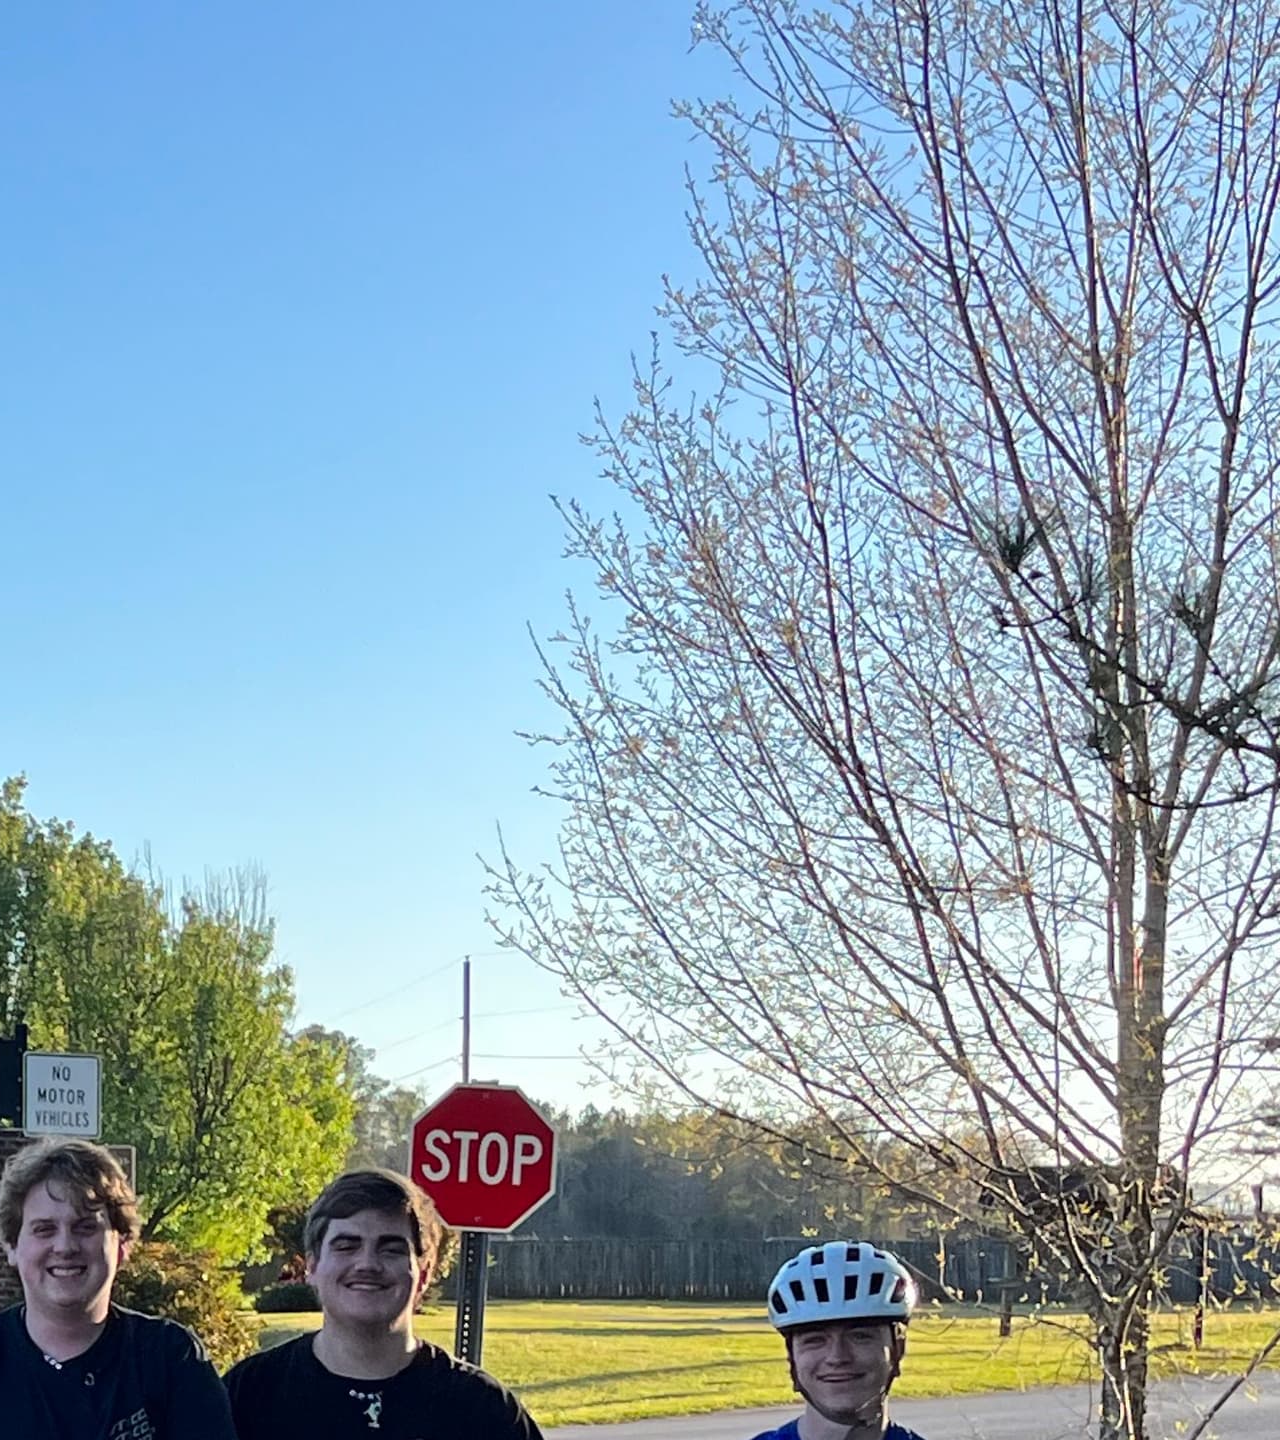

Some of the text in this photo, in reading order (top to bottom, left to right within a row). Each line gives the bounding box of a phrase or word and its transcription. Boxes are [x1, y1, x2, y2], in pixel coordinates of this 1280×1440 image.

[51, 1065, 72, 1082] NO
[36, 1087, 87, 1105] MOTOR
[34, 1109, 91, 1128] VEHICLES
[421, 1128, 544, 1186] STOP
